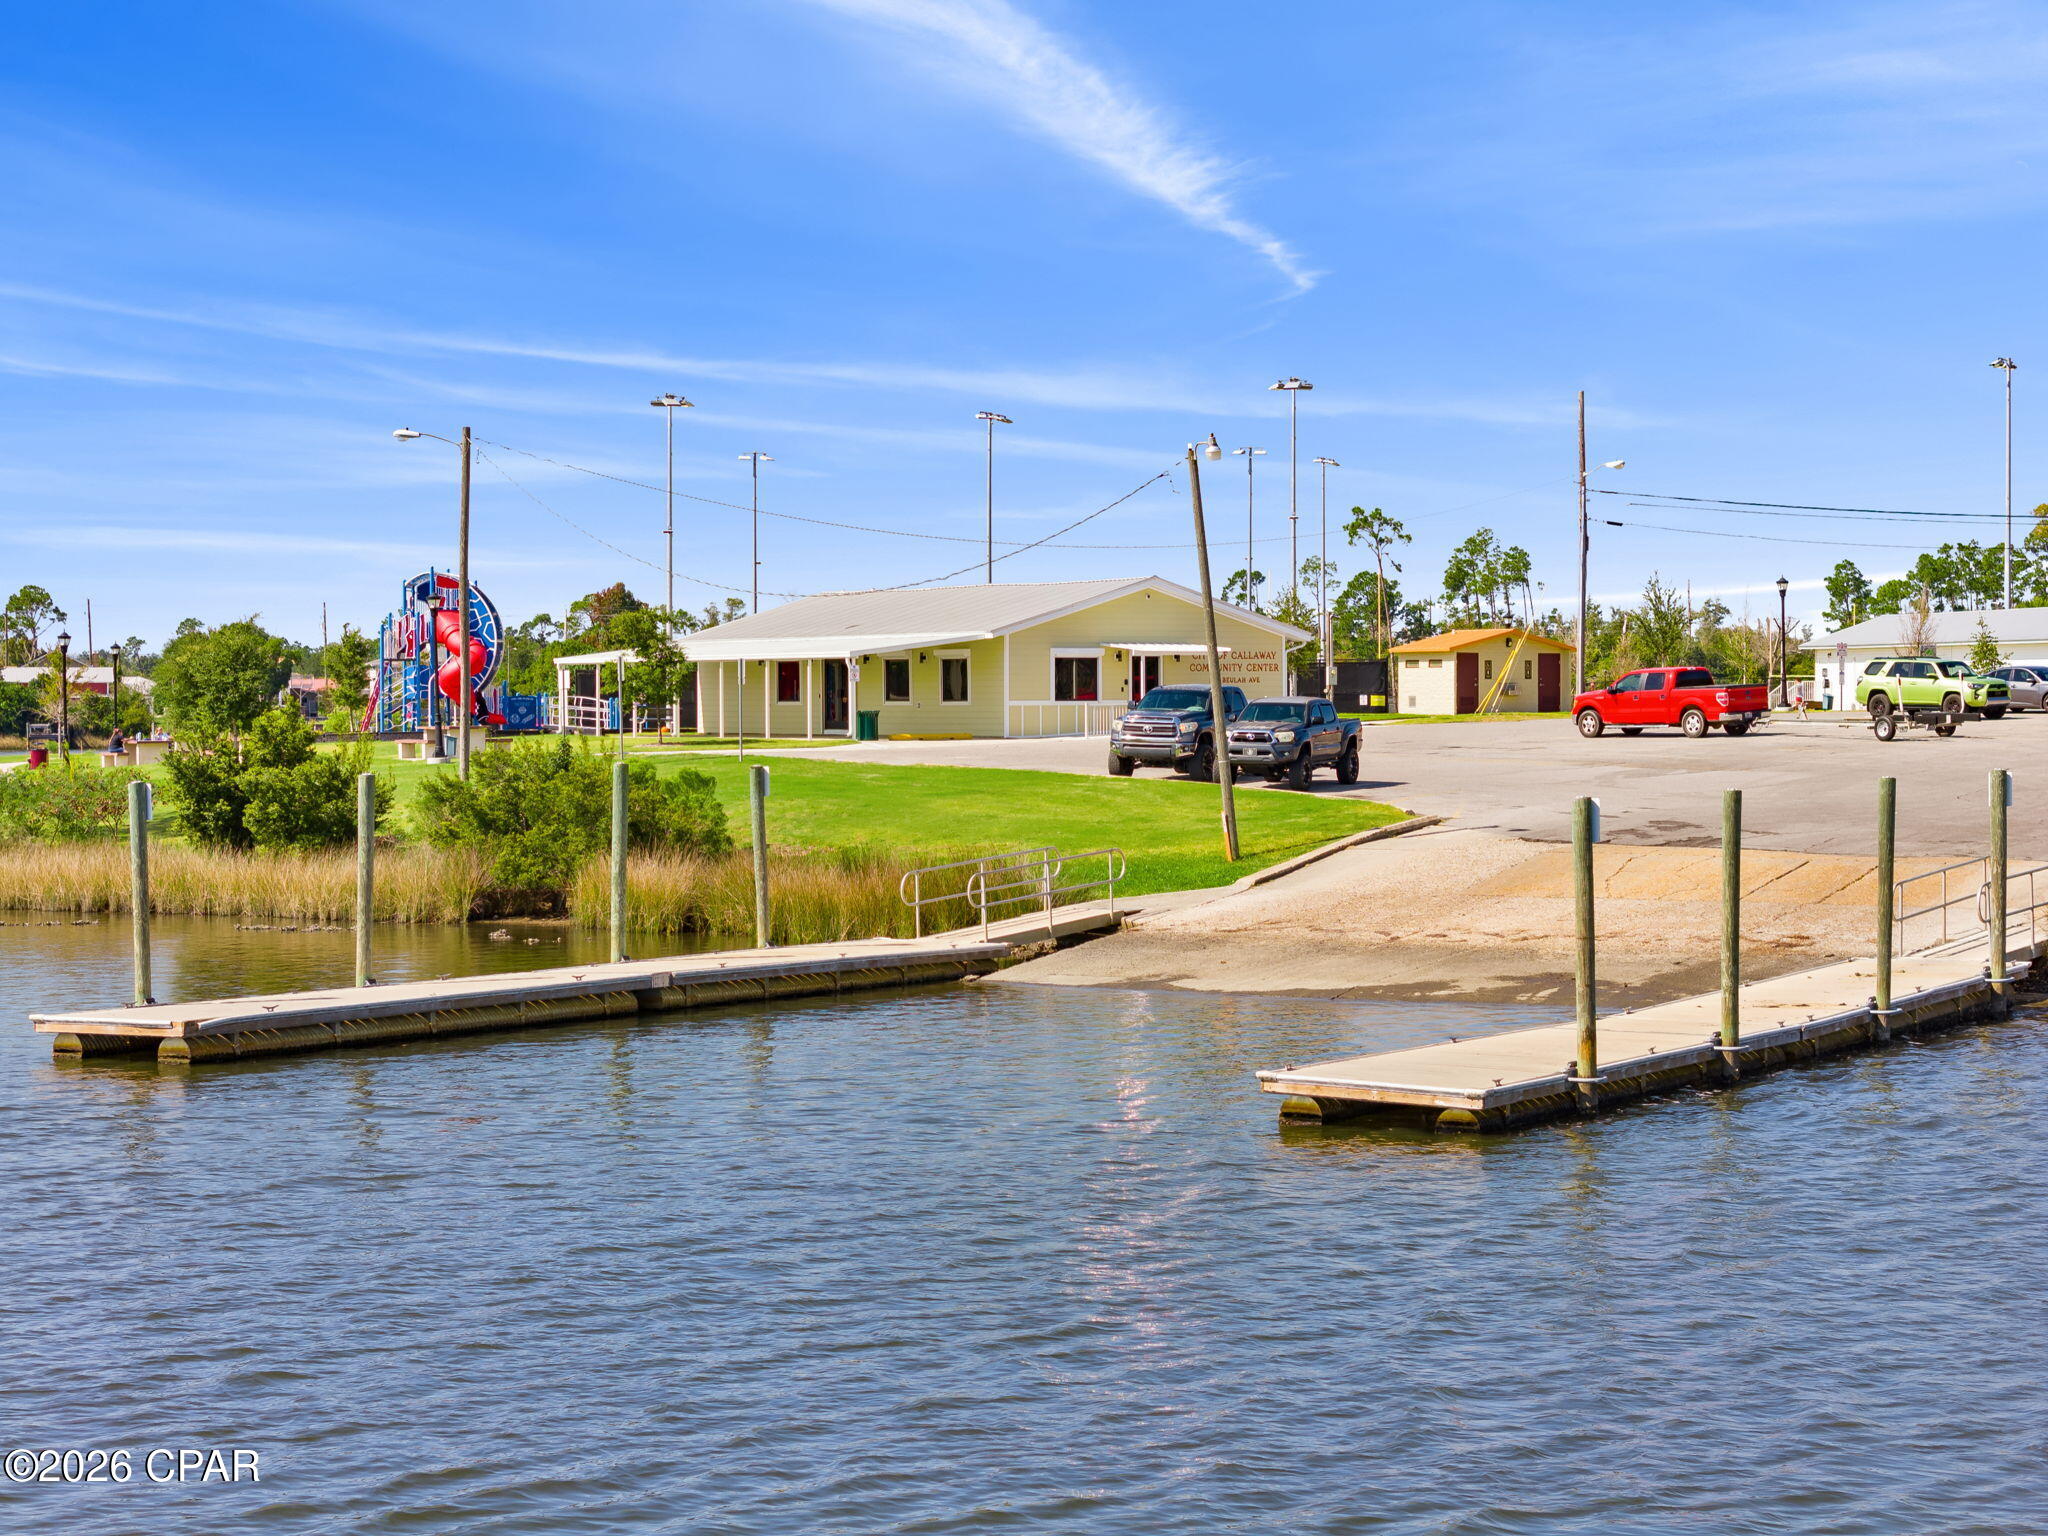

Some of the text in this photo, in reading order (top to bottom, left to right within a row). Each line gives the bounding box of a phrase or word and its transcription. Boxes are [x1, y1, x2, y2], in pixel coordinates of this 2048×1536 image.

[1231, 651, 1276, 660] CALLAWAY
[1189, 663, 1279, 672] COMNITY CENTER
[1222, 676, 1246, 684] BEULAH
